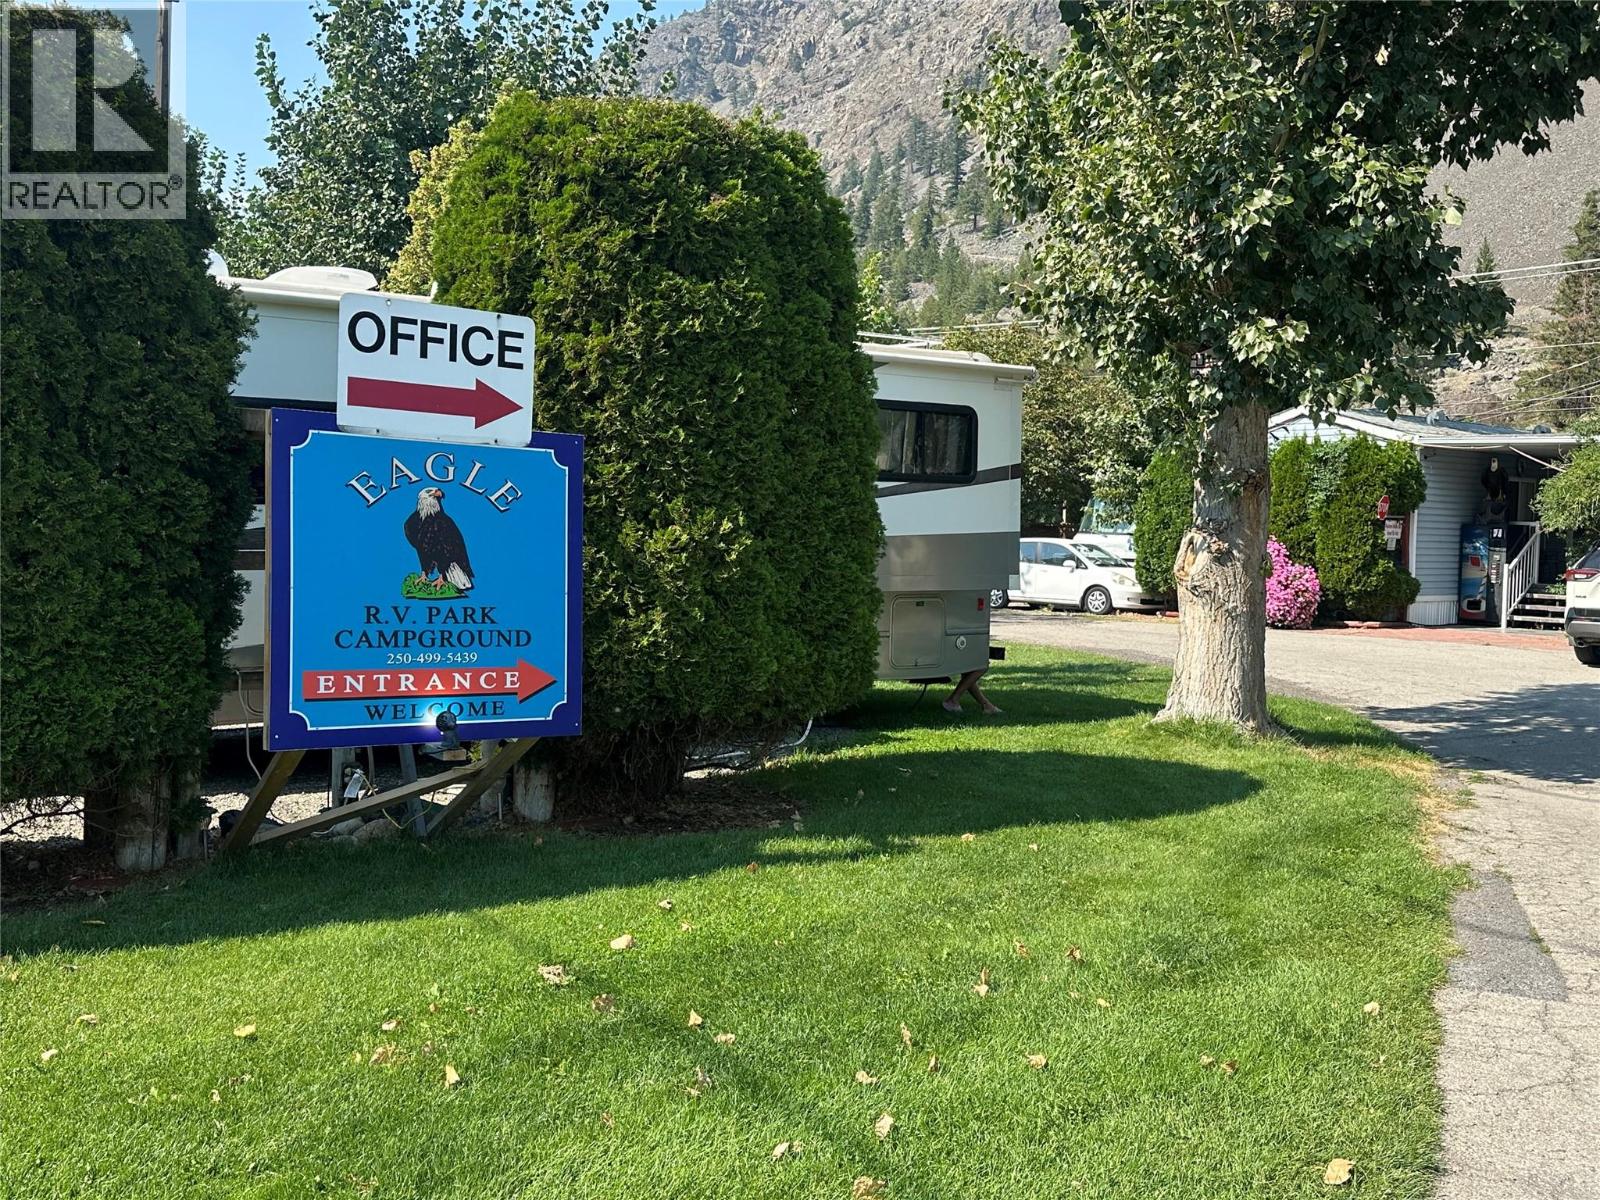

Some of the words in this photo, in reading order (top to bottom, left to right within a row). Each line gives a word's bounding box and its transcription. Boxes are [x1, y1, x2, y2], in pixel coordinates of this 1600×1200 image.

[347, 311, 525, 370] OFFICE
[346, 452, 524, 512] EAGLE
[364, 605, 417, 625] R.V.
[427, 605, 498, 625] PARK
[334, 629, 532, 649] CAMPGROUND
[386, 652, 478, 665] 250-499-5439
[316, 671, 521, 694] ENTRANCE
[364, 701, 505, 720] WELCOME
